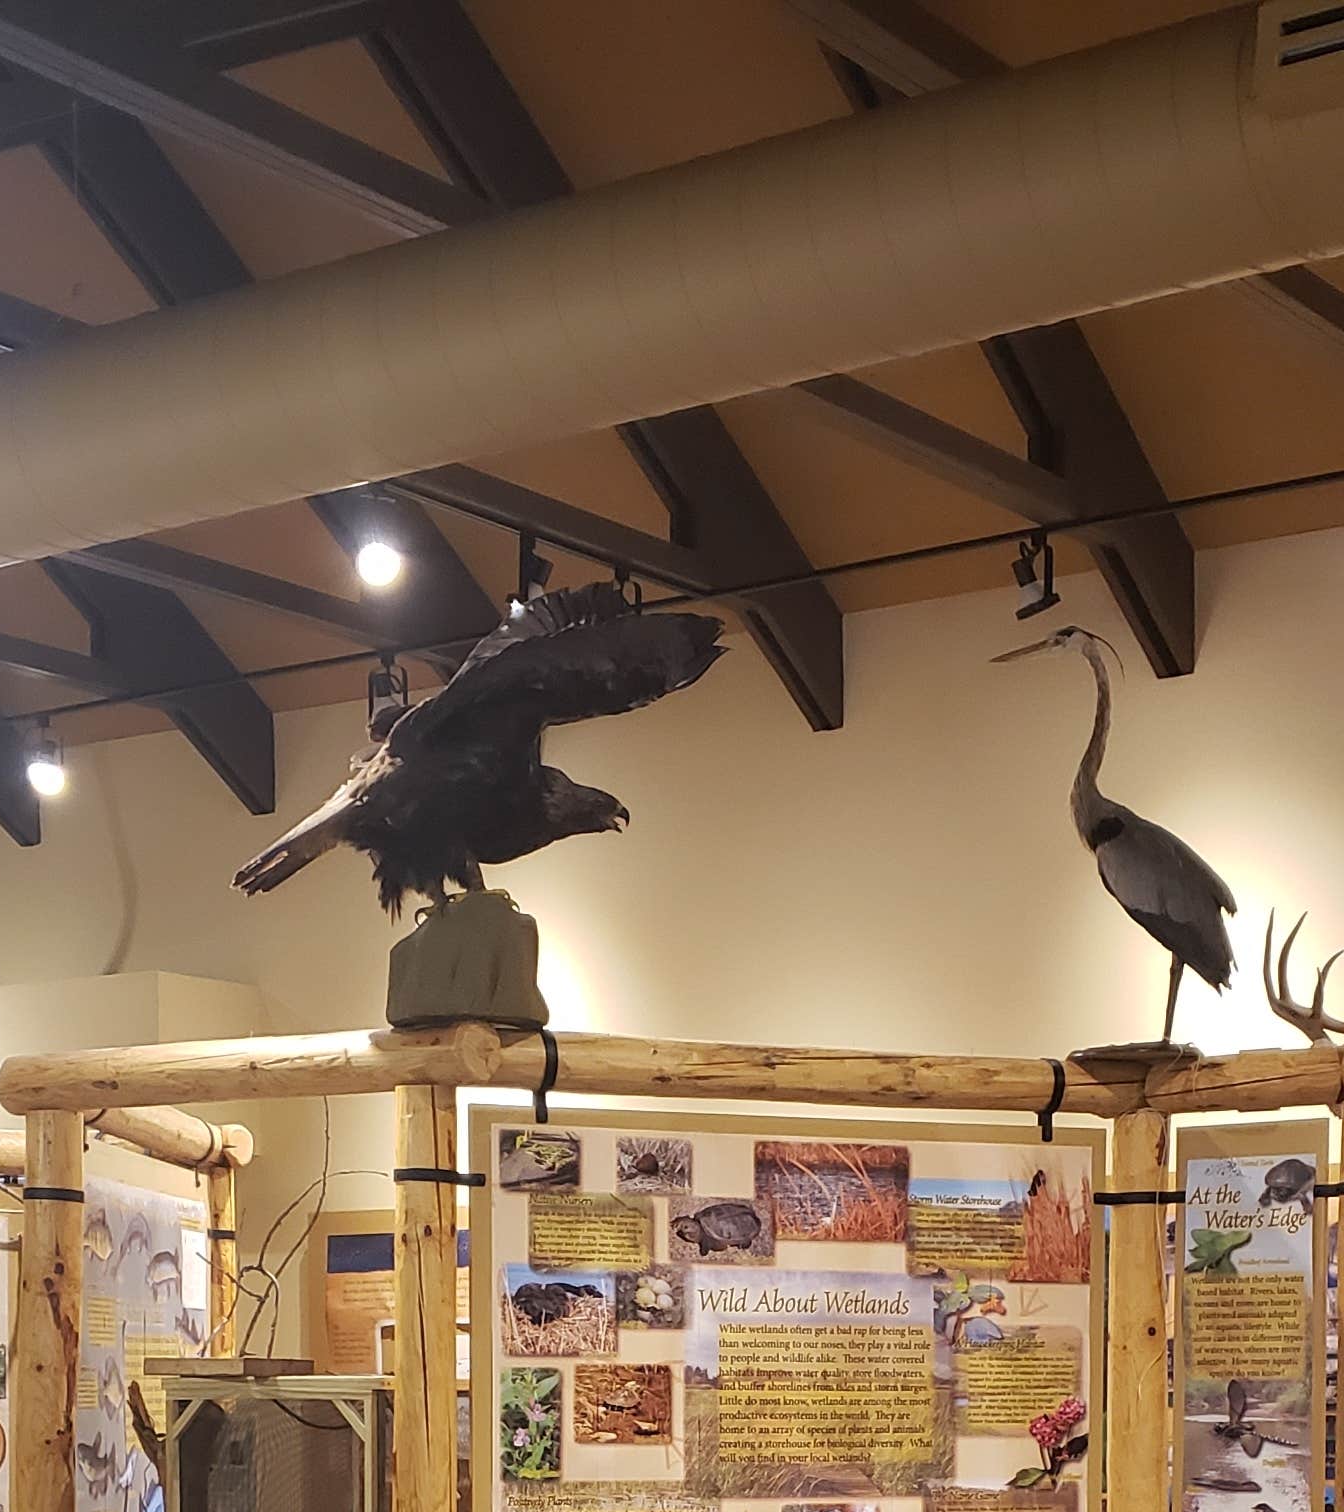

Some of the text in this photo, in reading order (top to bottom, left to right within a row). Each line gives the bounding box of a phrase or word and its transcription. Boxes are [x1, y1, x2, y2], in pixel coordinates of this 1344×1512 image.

[909, 1193, 933, 1204] Storm
[936, 1194, 959, 1204] Water
[1188, 1183, 1241, 1205] At the
[1205, 1206, 1307, 1234] Water's Edge
[698, 1287, 910, 1315] Wild About Wetlands
[719, 1324, 747, 1334] While
[748, 1324, 788, 1334] wetlands
[790, 1325, 812, 1334] often
[814, 1326, 827, 1337] get
[837, 1325, 851, 1335] bad
[854, 1328, 867, 1337] rap
[869, 1326, 880, 1335] for
[882, 1326, 906, 1338] being
[908, 1326, 923, 1335] less
[719, 1338, 739, 1348] than
[742, 1338, 790, 1351] welcoming
[848, 1339, 865, 1351] they
[868, 1339, 885, 1352] play
[893, 1340, 911, 1350] vital
[913, 1340, 931, 1350] role
[719, 1354, 728, 1362] to
[730, 1353, 760, 1365] people
[762, 1353, 779, 1362] and
[782, 1352, 814, 1363] wildlife
[843, 1354, 866, 1364] These
[892, 1354, 925, 1364] covered
[719, 1396, 742, 1405] Little
[745, 1396, 757, 1405] do
[759, 1398, 781, 1406] most
[811, 1396, 847, 1406] wetlands
[863, 1399, 891, 1408] among
[894, 1396, 907, 1405] the
[909, 1398, 931, 1406] most
[548, 1496, 573, 1506] Plants
